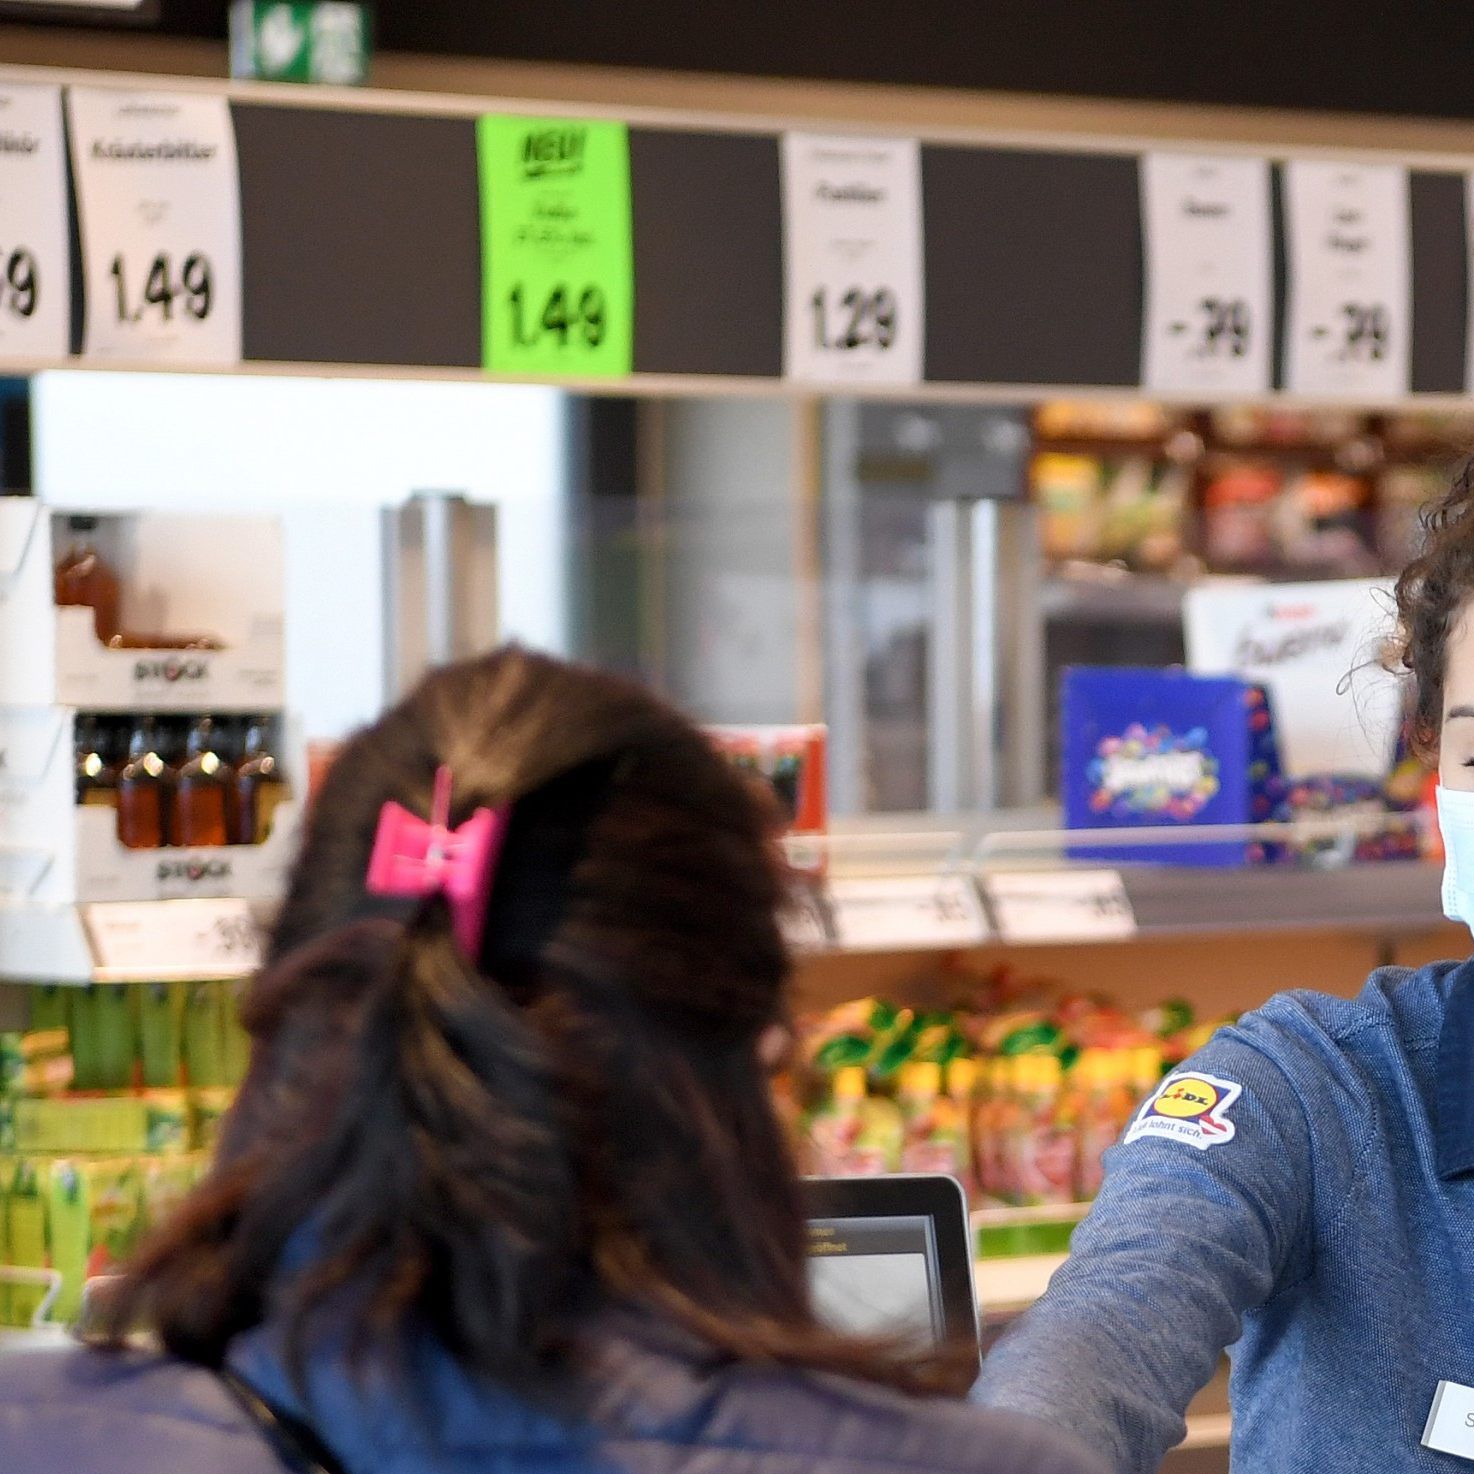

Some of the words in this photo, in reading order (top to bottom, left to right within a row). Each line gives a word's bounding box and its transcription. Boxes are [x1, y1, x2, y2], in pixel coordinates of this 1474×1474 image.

[109, 252, 213, 323] 1.49
[508, 283, 606, 348] 1.49
[812, 285, 897, 351] 1.29
